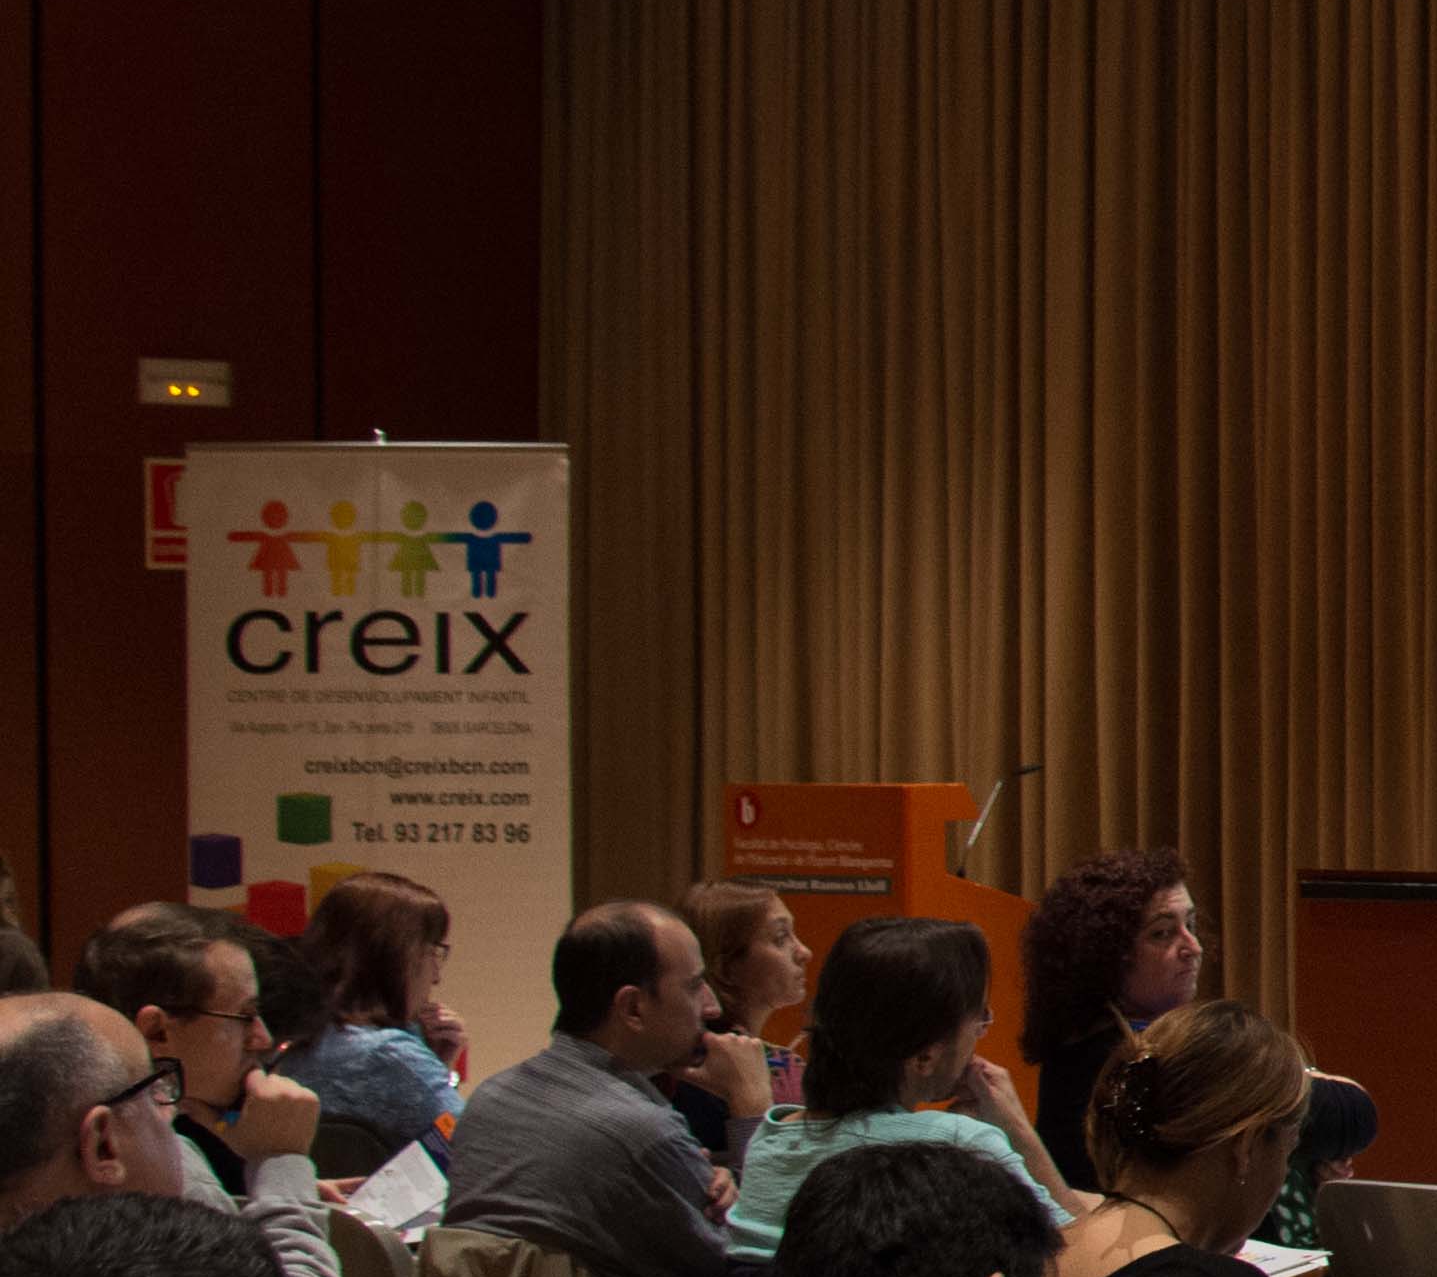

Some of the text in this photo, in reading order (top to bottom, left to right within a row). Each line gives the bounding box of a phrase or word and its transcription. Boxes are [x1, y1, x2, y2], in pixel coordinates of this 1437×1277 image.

[226, 607, 533, 676] creix
[304, 755, 530, 778] creixbcn@creixbcn.com
[390, 788, 530, 806] www.creix.com
[394, 823, 420, 843] 93
[427, 823, 465, 843] 217
[472, 823, 498, 843] 83
[503, 823, 530, 843] 96
